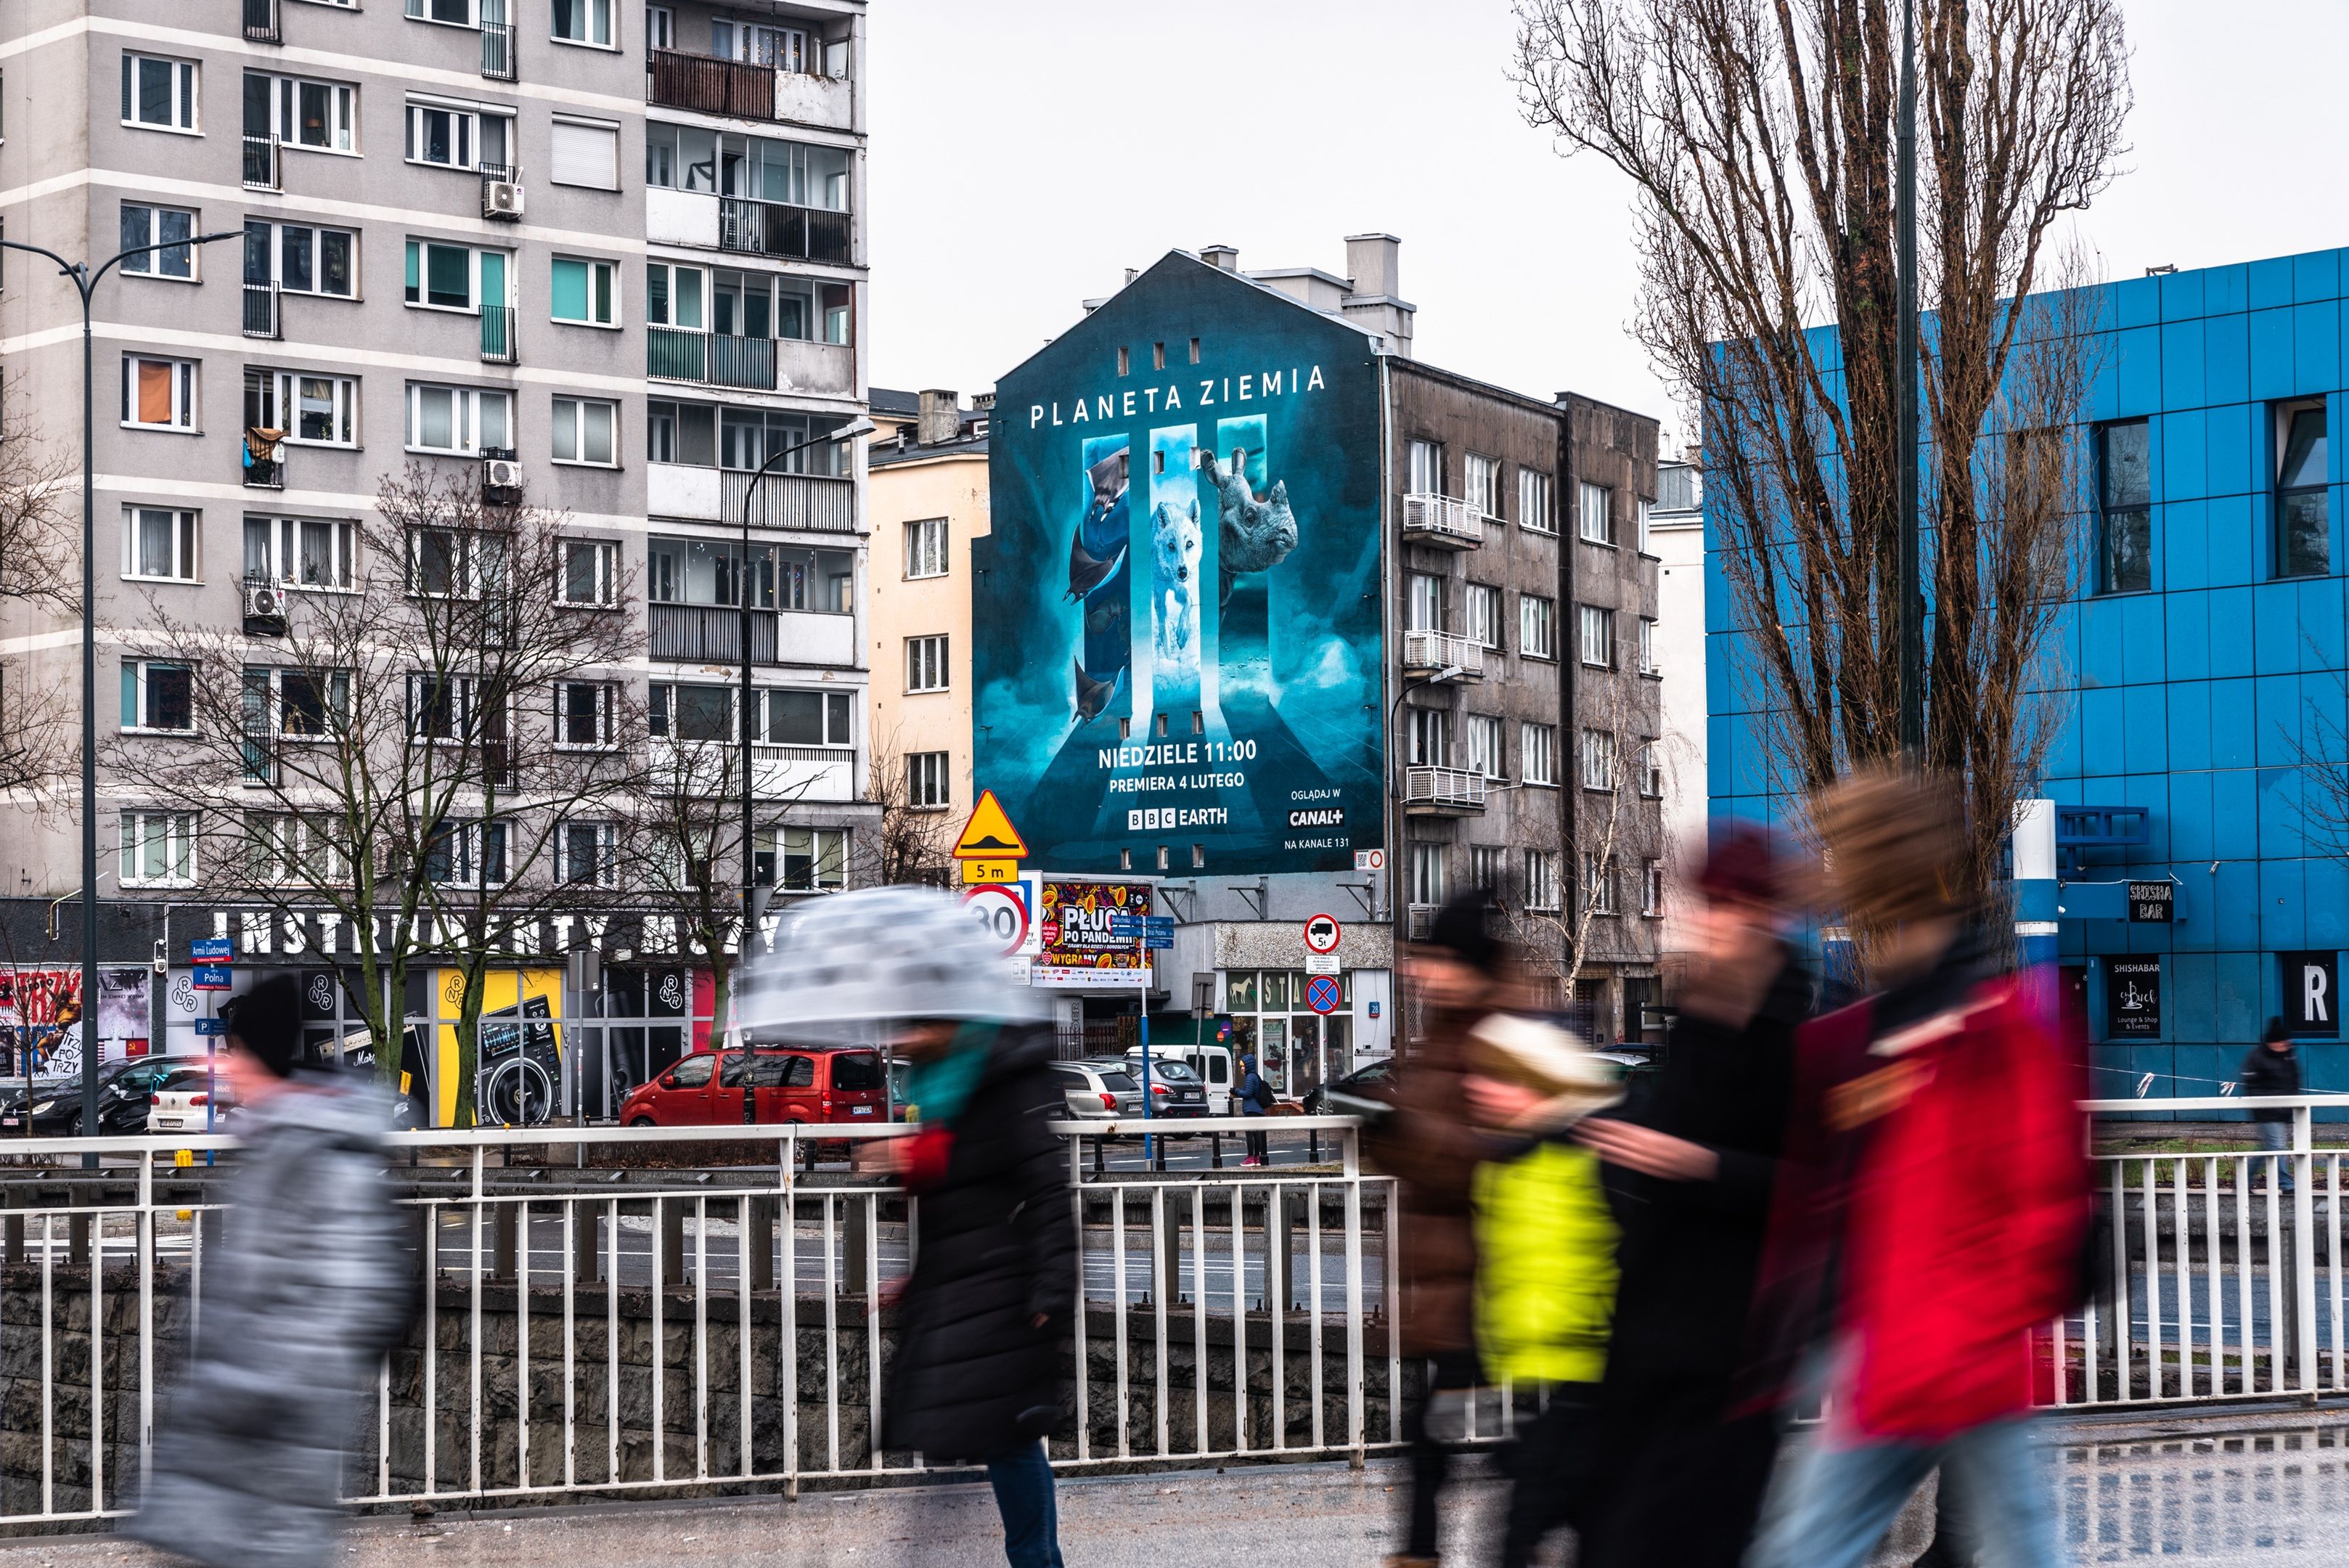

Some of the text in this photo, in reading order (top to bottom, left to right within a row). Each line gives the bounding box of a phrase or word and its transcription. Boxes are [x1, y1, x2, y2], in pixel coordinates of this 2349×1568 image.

[1031, 365, 1325, 429] PLANETA ZIEMIA
[1098, 740, 1257, 769] NIEDZIELE 11:00
[1110, 772, 1244, 793] PREMIERA 4 LUTEGO
[1291, 789, 1330, 801] OGLĄDAJ
[1130, 808, 1227, 828] BBC EARTH
[1290, 809, 1343, 826] CANAL+
[1285, 838, 1349, 849] NA KANALE 131
[977, 865, 1003, 878] 5 m
[2130, 885, 2172, 901] SHISHA
[2140, 904, 2162, 919] BAR
[971, 906, 1016, 939] 30
[1064, 931, 1079, 942] PO
[1082, 931, 1132, 944] PANDEMII
[192, 944, 229, 956] Armii Ludowej
[1052, 953, 1097, 965] WYGRAMY
[2115, 964, 2160, 973] SHISHABAR
[204, 973, 224, 982] Polna
[1265, 976, 1352, 1004] STAA
[2304, 965, 2328, 1021] R
